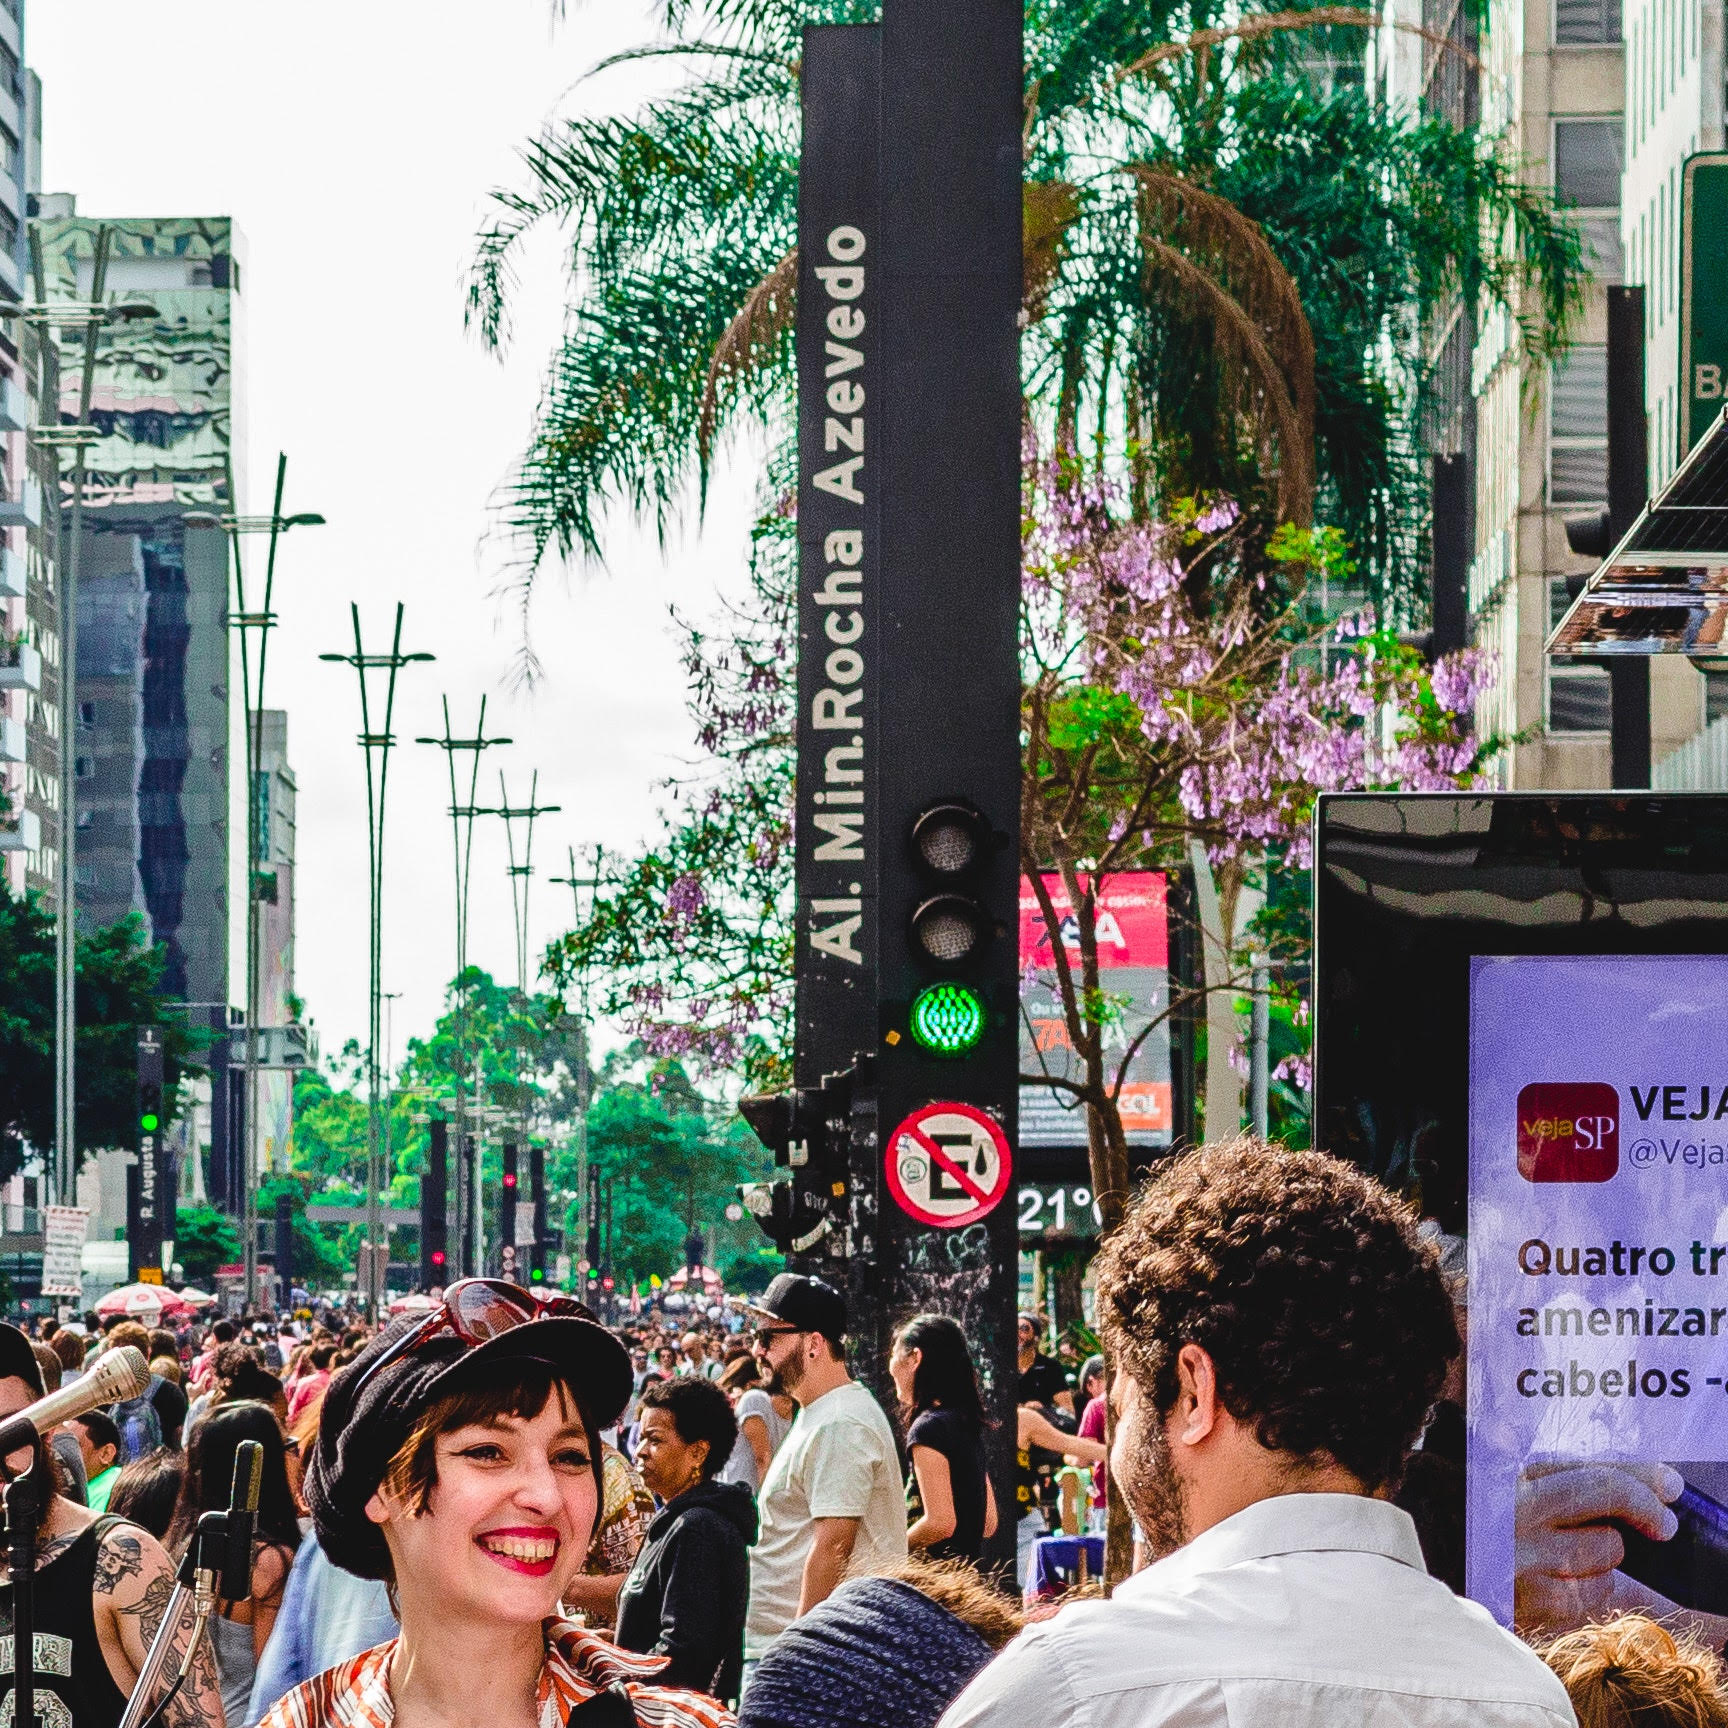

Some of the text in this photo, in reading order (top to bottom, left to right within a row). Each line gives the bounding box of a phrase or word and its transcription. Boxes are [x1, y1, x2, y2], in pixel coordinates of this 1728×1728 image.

[812, 224, 867, 506] Azevedo
[1696, 363, 1728, 399] B
[810, 881, 863, 966] Al.
[1523, 1116, 1615, 1150] veja SP
[140, 1136, 157, 1202] Augusta
[1627, 1138, 1728, 1170] @Veja
[1517, 1238, 1676, 1278] Quatro
[1516, 1301, 1728, 1338] amenizar
[1516, 1359, 1692, 1399] cabelos
